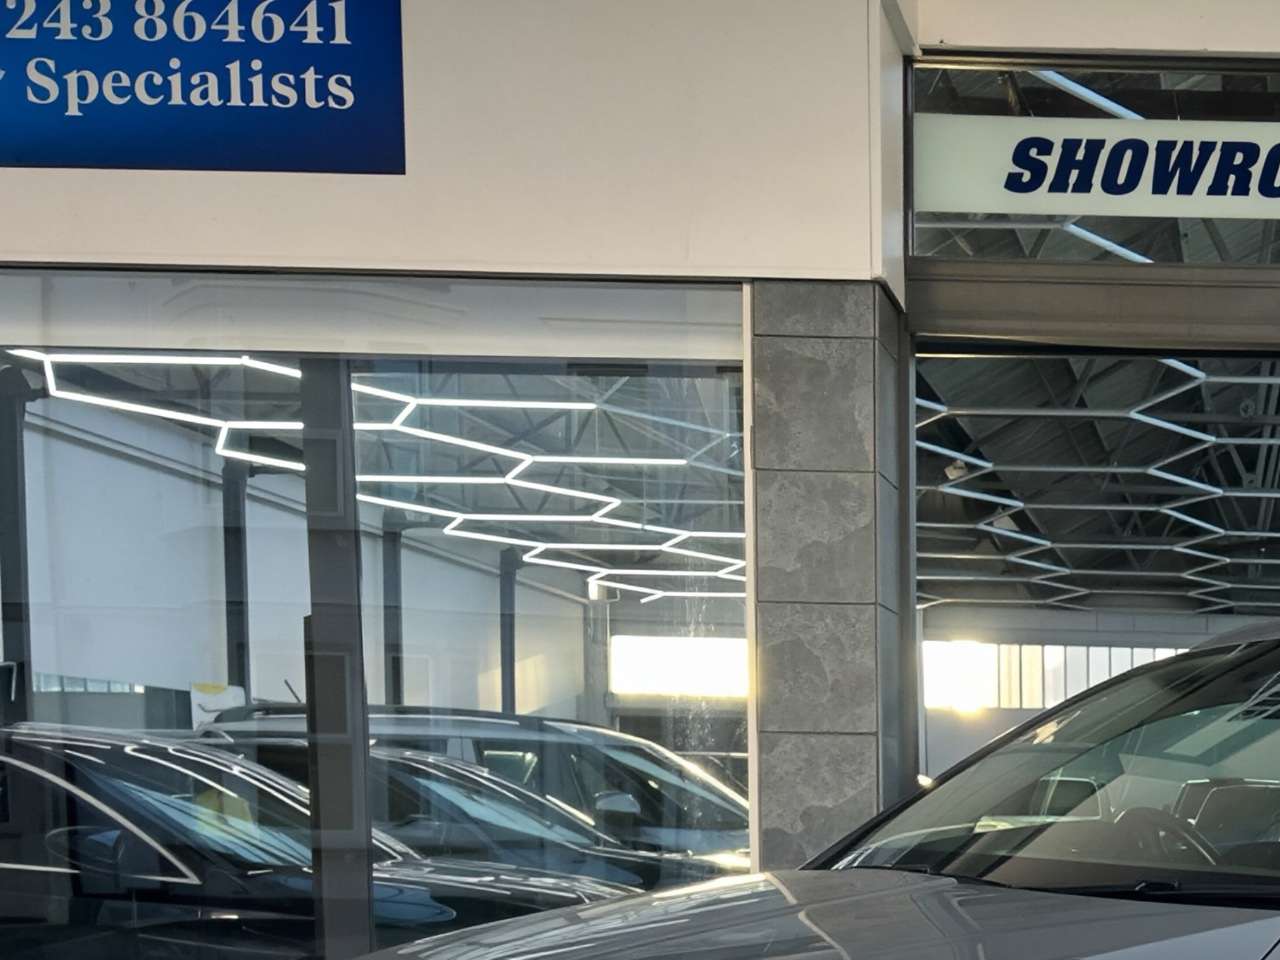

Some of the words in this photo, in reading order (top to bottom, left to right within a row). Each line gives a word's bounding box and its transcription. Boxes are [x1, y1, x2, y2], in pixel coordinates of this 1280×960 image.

[5, 0, 114, 41] 243
[133, 0, 352, 45] 864641
[26, 57, 355, 117] Specialists
